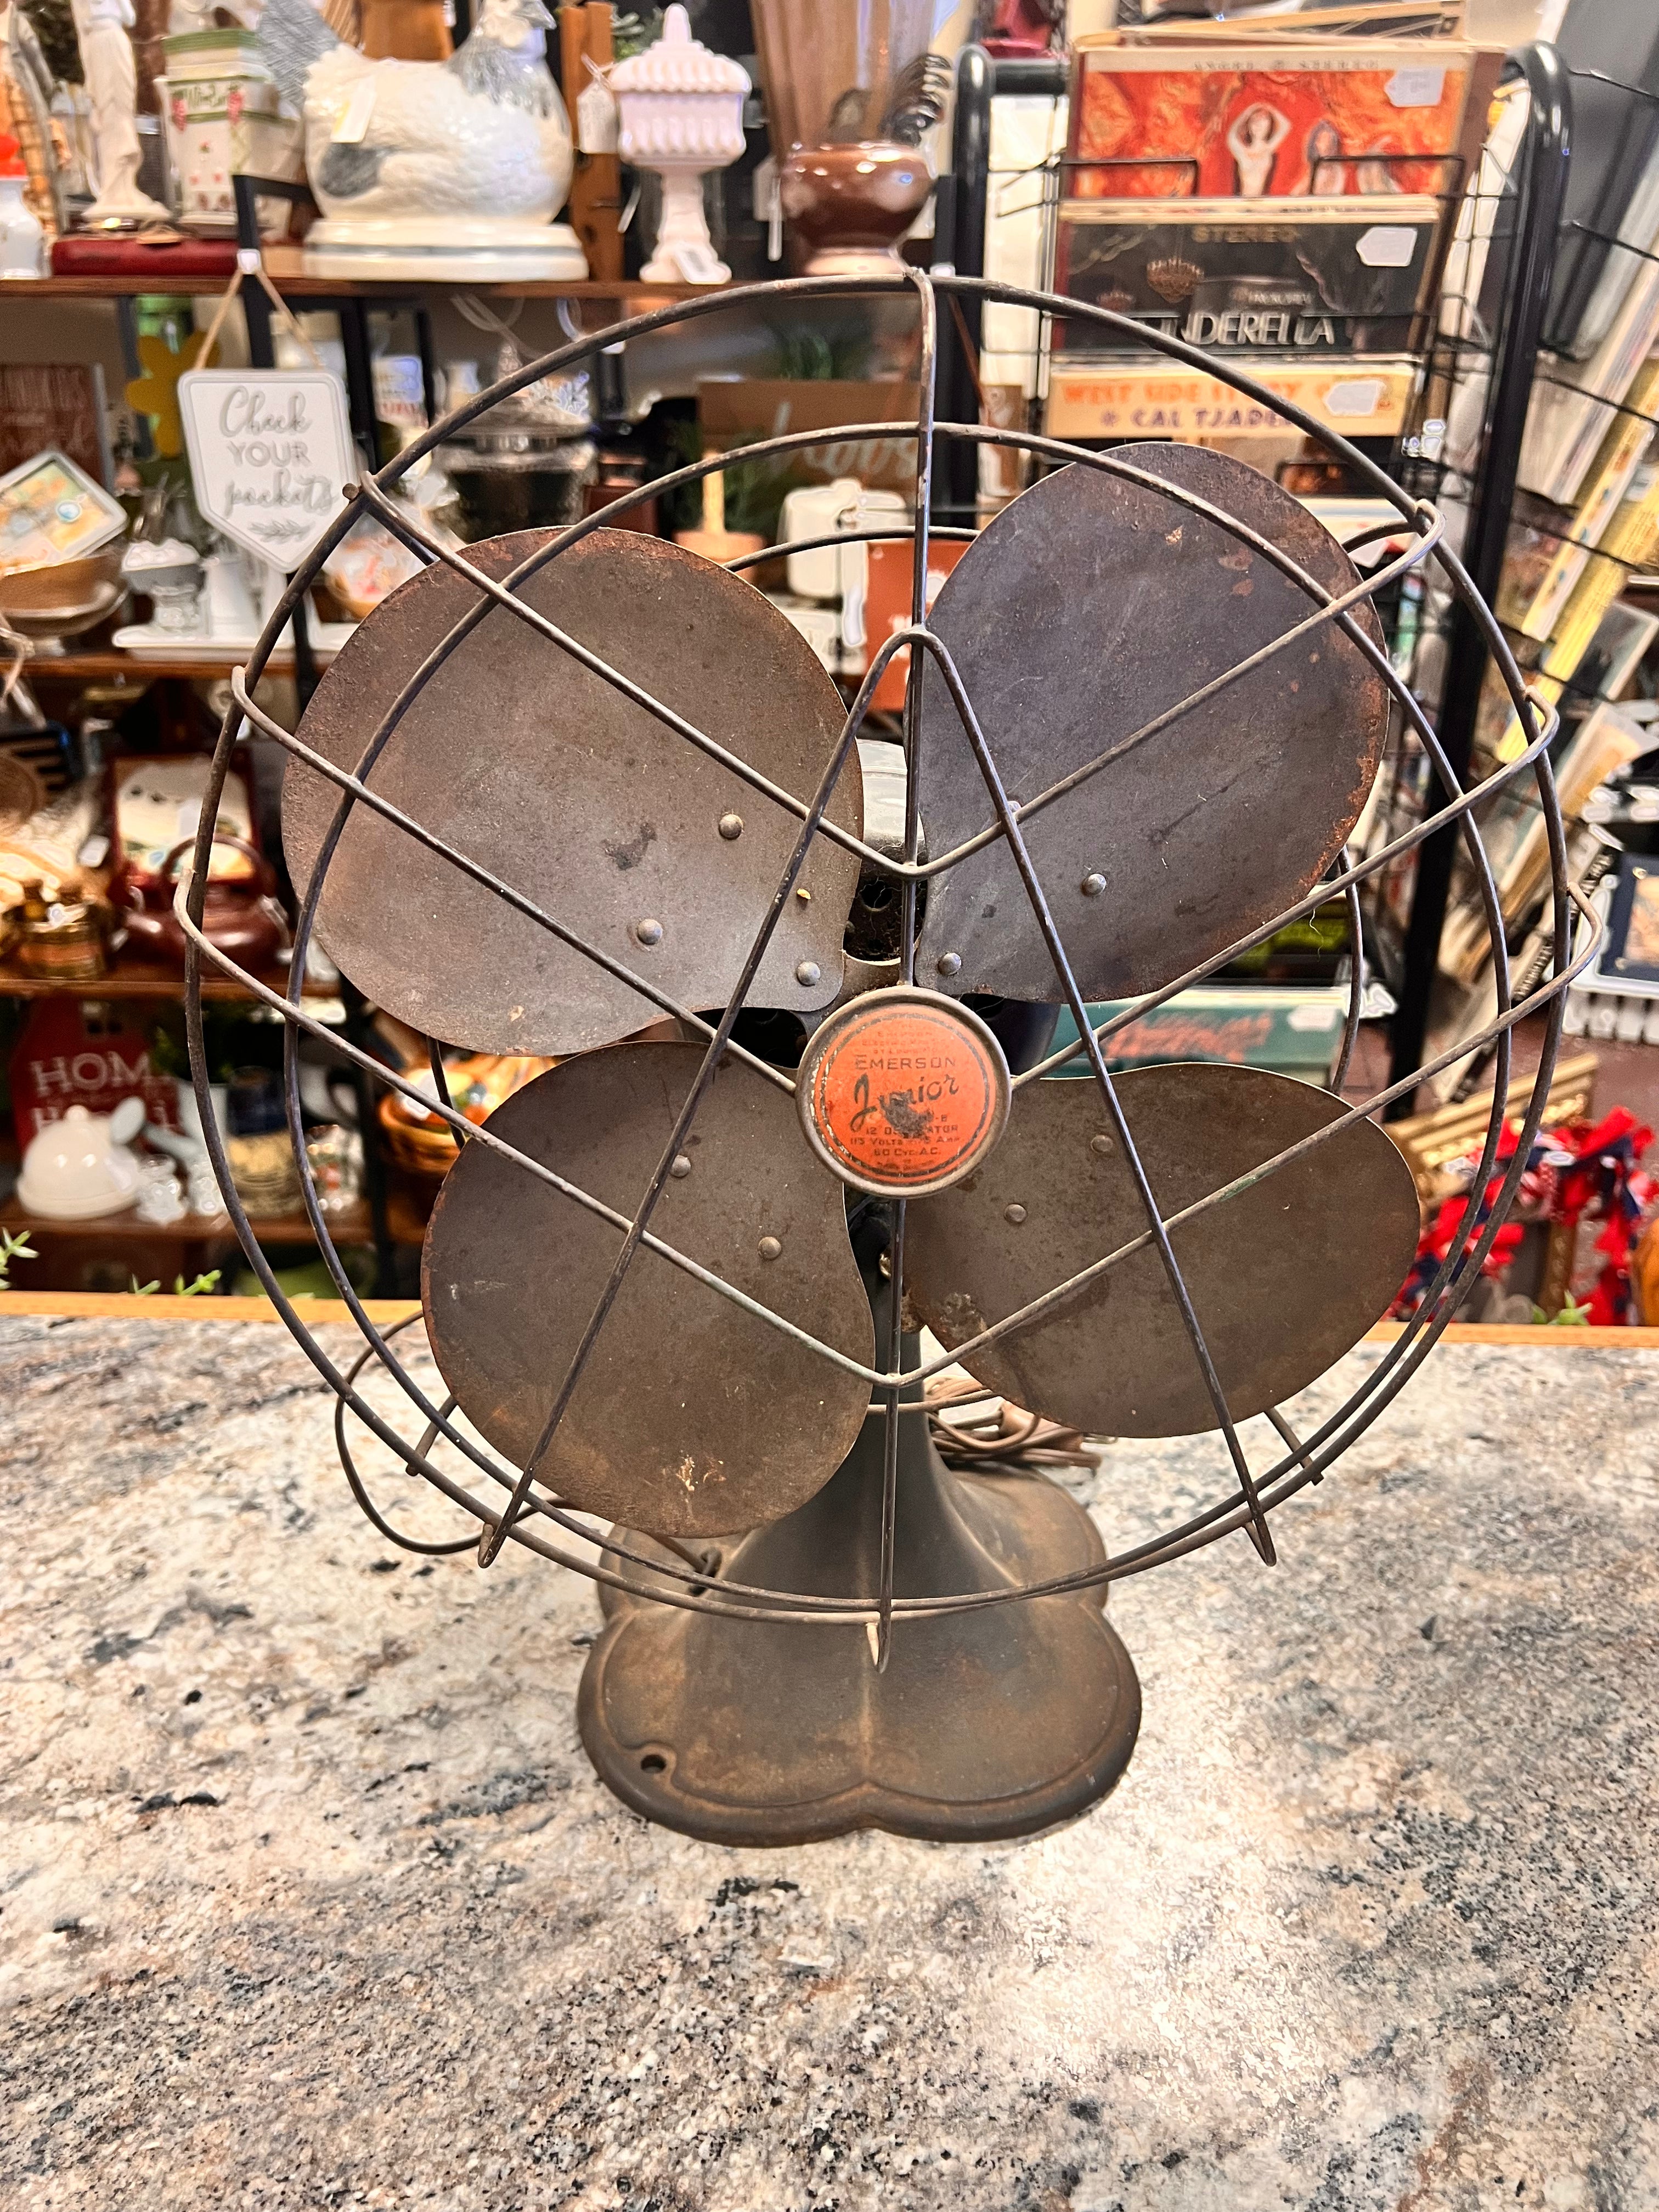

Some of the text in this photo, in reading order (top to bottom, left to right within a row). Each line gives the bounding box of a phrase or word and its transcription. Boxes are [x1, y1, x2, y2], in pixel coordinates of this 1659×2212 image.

[219, 385, 313, 437] Check
[1130, 409, 1182, 427] CAL
[227, 441, 313, 467] YOUR
[223, 467, 341, 519] pockets
[29, 1050, 176, 1098] HOM
[854, 1054, 956, 1070] EMERSON
[850, 1073, 960, 1132] Junior
[850, 1137, 865, 1146] 115
[866, 1126, 877, 1135] 12
